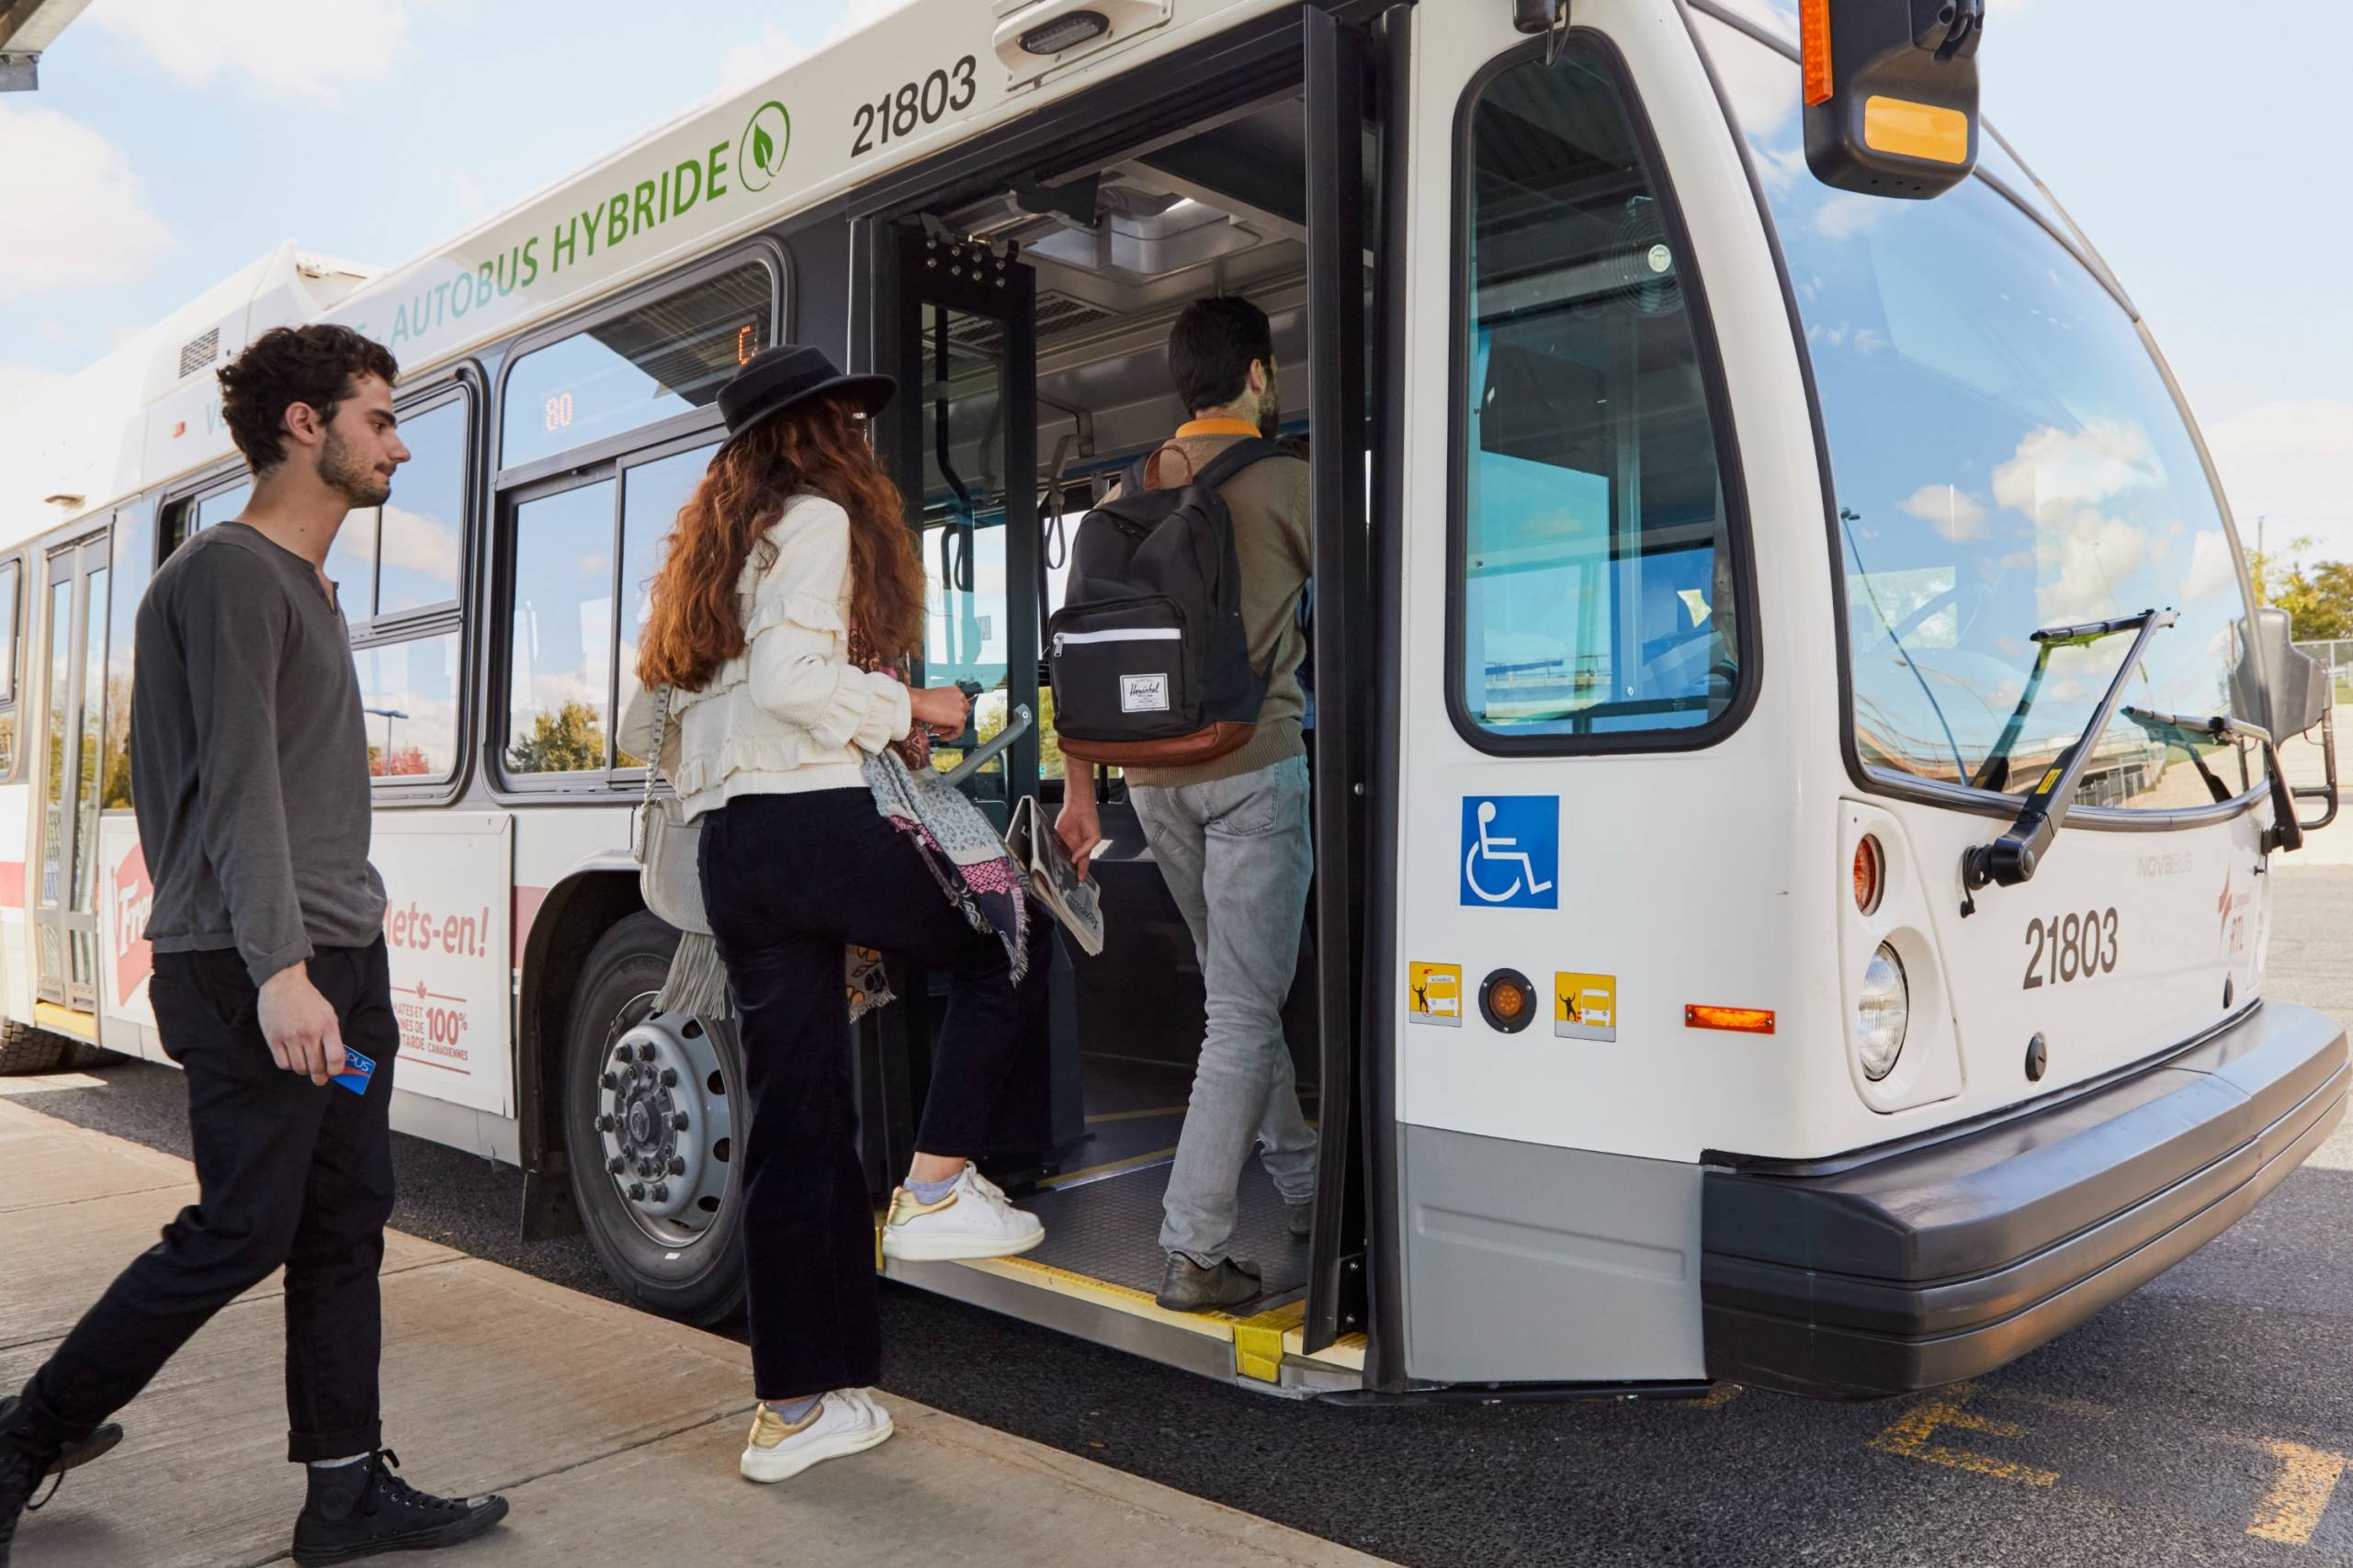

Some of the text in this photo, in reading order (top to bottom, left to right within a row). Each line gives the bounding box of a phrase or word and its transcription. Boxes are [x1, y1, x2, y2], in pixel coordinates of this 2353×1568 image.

[851, 54, 977, 158] 21803
[390, 140, 730, 348] AUTOBUS HYBRIDE
[544, 390, 573, 432] 80
[119, 878, 153, 957] Fre
[2023, 907, 2118, 989] 21803
[401, 1033, 424, 1051] TARDE
[425, 1007, 468, 1045] 100%
[346, 1052, 372, 1072] PUS
